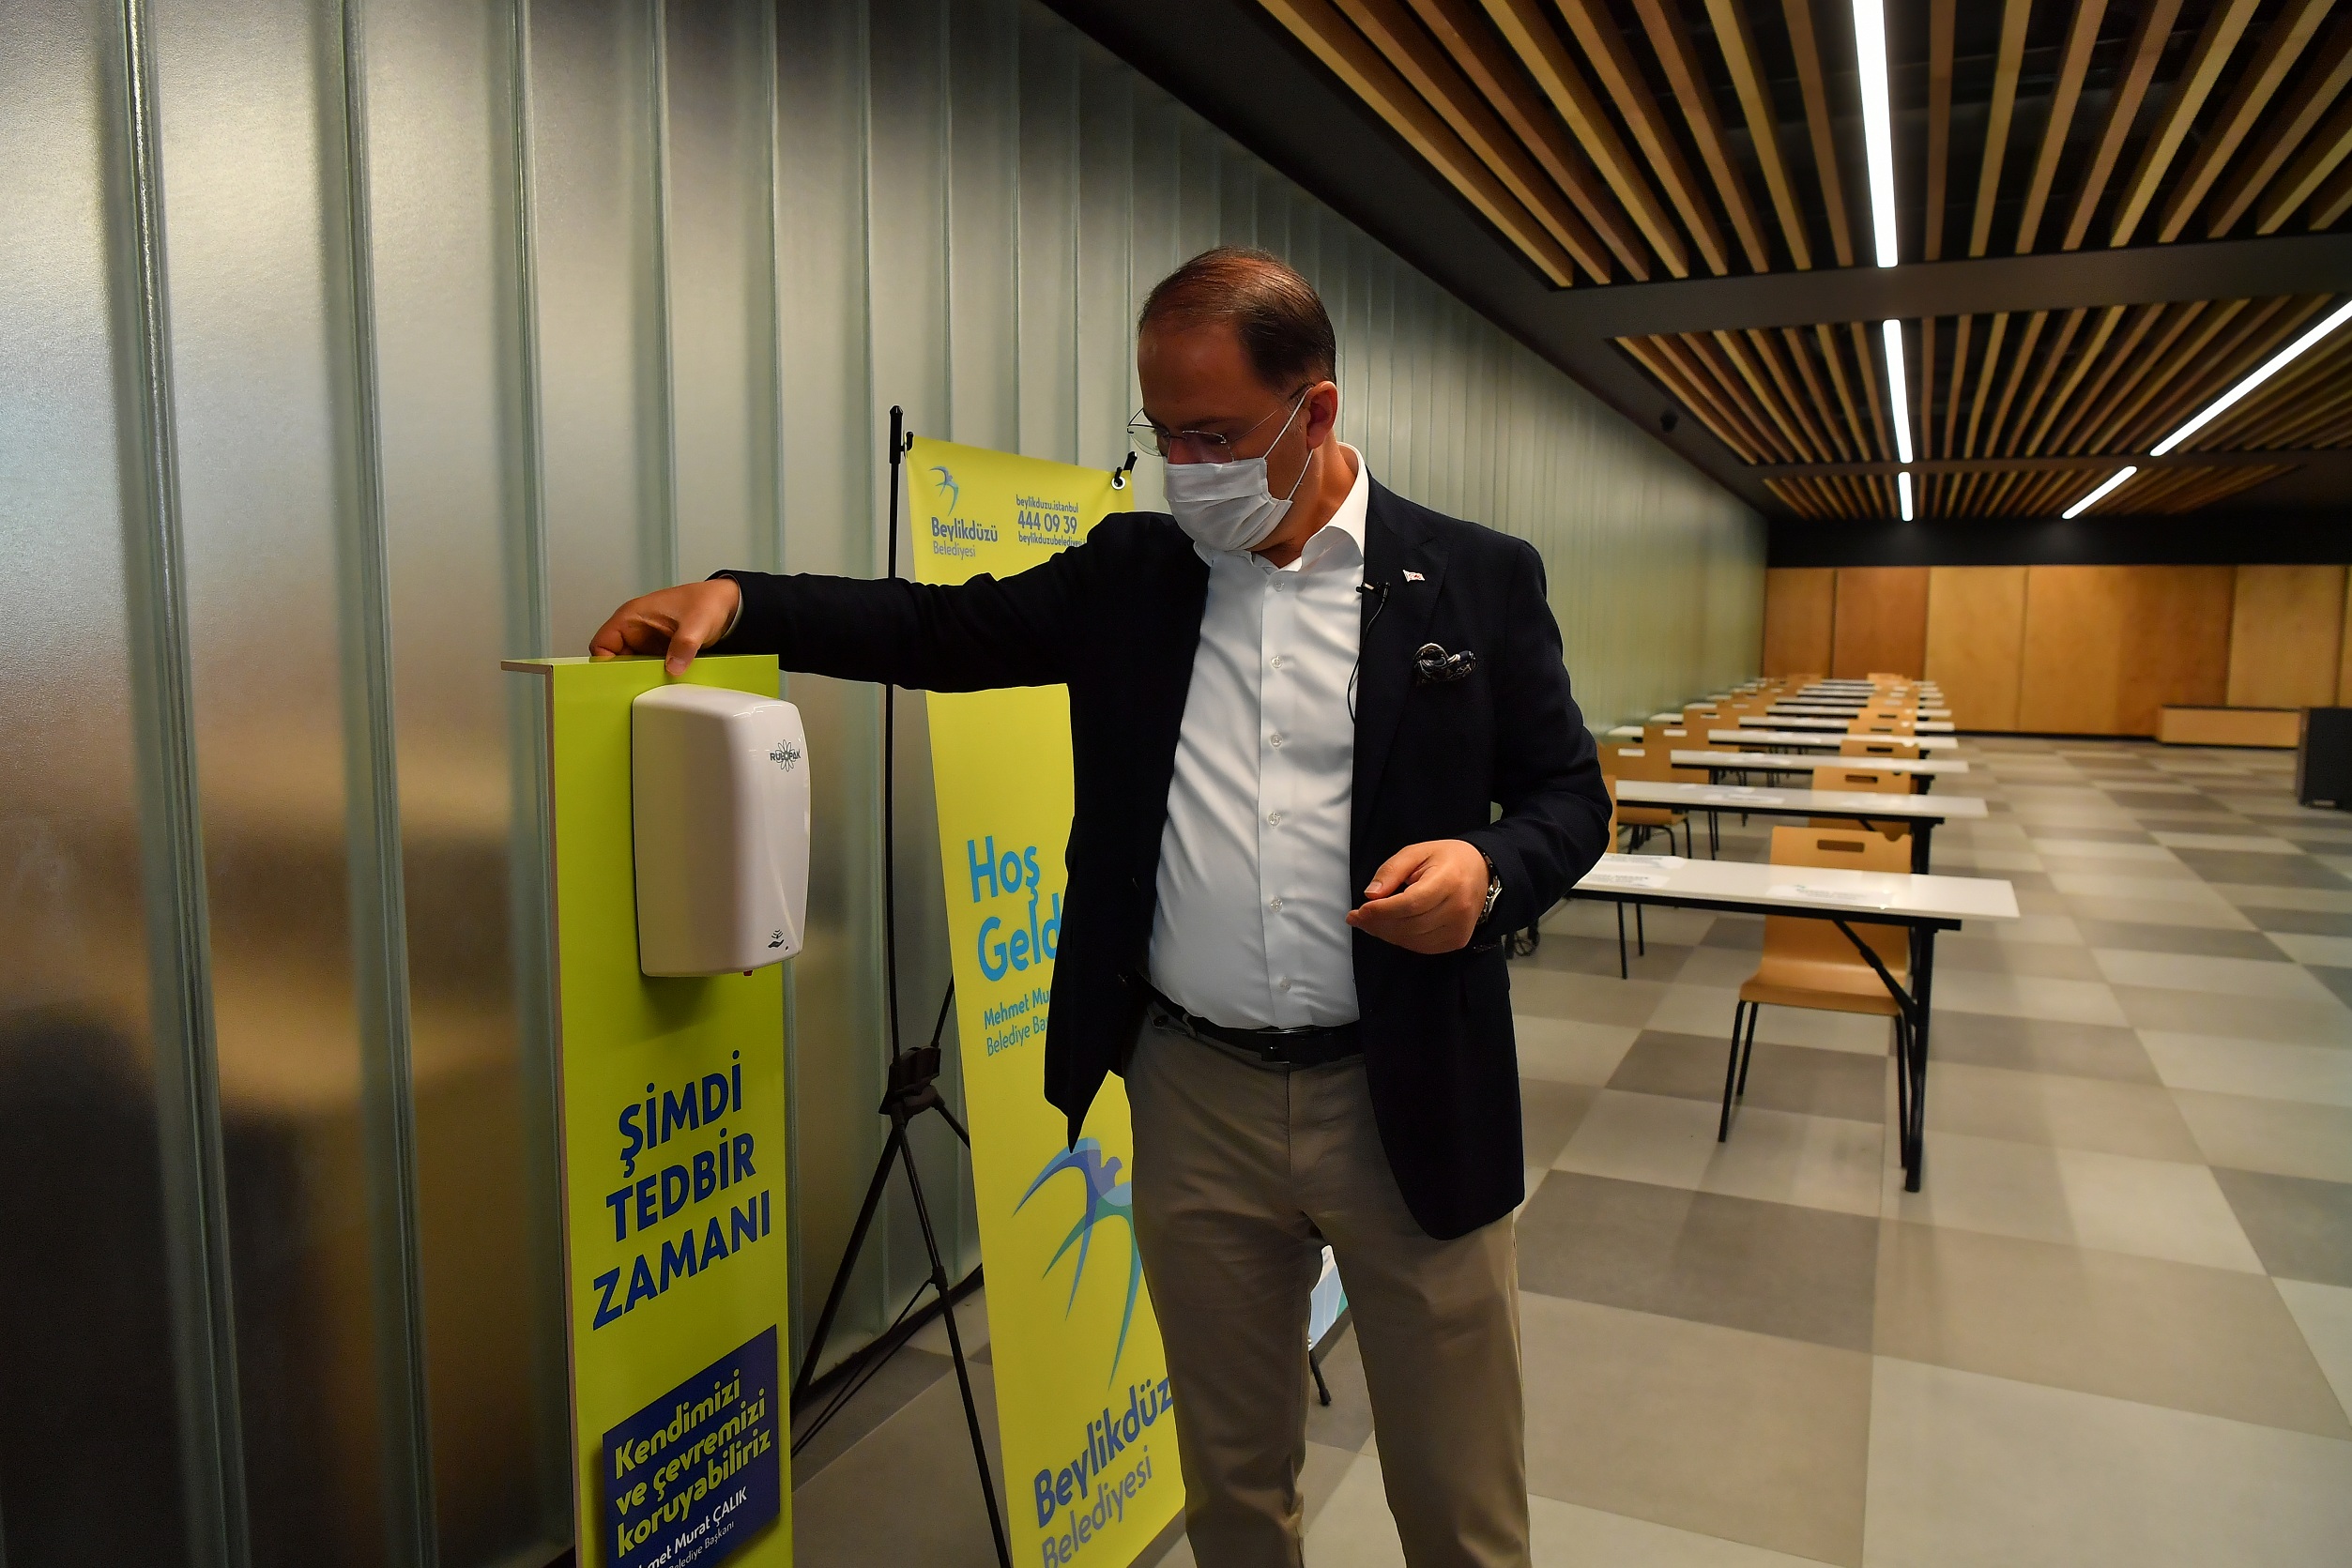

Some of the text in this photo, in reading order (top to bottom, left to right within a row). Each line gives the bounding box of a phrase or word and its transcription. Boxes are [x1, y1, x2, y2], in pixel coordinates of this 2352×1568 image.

[932, 517, 998, 541] Beylikdüzü
[1016, 495, 1078, 512] beylikduzu.istanbul
[1018, 510, 1077, 534] 444 09 39
[933, 540, 975, 560] Belediyesi
[968, 835, 1040, 907] Hoş
[978, 892, 1061, 982] Geld
[985, 988, 1049, 1030] Mehmet Mu
[987, 1016, 1048, 1057] Belediye Ba
[619, 1050, 741, 1179] ŞİMDİ
[606, 1128, 756, 1242] TEDBİR
[593, 1190, 770, 1331] ZAMANI
[615, 1369, 740, 1480] Kendimizi
[616, 1388, 765, 1515] ve çevremizi
[1034, 1378, 1173, 1528] Beylikdüz
[618, 1428, 771, 1559] koruyabiliriz
[675, 1515, 710, 1554] Murat
[713, 1486, 747, 1527] ÇALIK
[1042, 1445, 1152, 1568] Belediyesi
[705, 1521, 734, 1549] Başkanı
